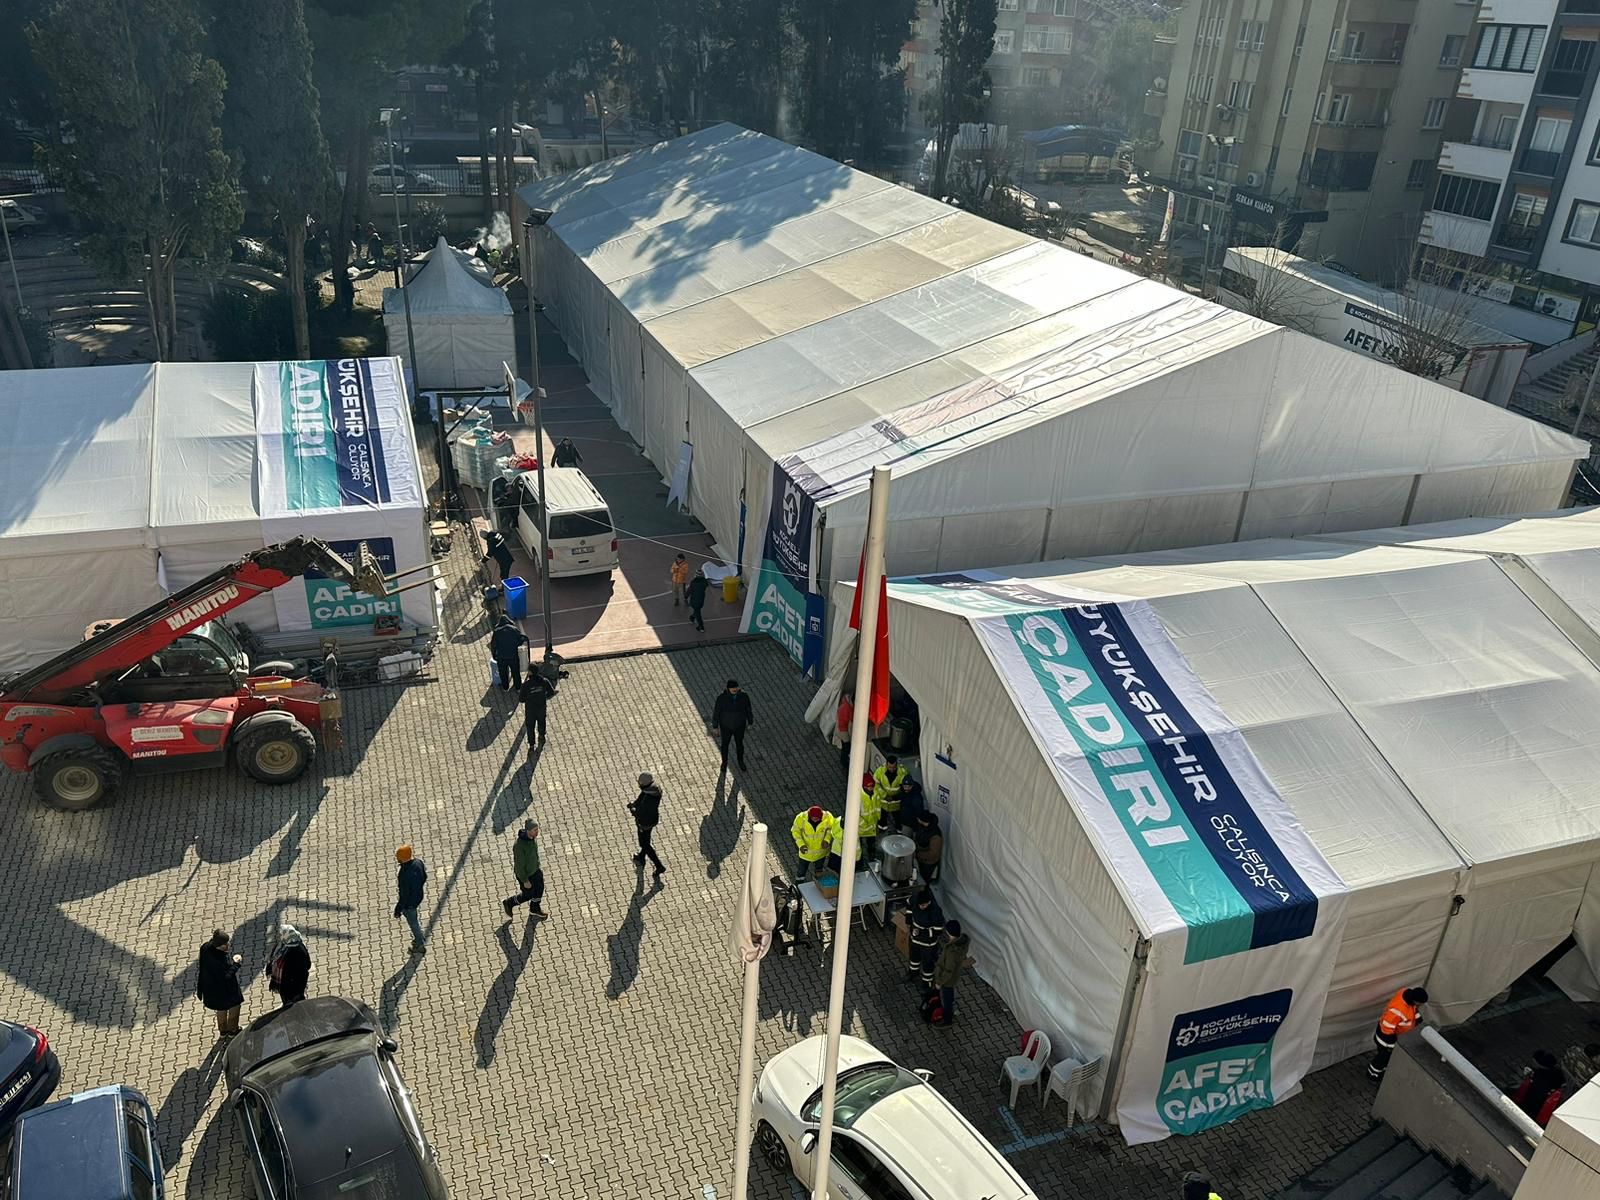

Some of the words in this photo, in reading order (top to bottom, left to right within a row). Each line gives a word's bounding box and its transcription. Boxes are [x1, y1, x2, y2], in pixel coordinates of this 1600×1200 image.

[1344, 328, 1382, 354] AFET
[290, 366, 328, 457] ADIRI
[337, 358, 364, 438] ÜKŞEHİR
[348, 444, 361, 481] OLUYOR
[166, 584, 239, 631] MANITOU
[313, 582, 393, 604] AFE
[314, 601, 397, 620] ÇADIRI
[760, 583, 805, 638] AFET
[756, 611, 804, 659] ÇADIR
[1075, 603, 1217, 803] ÜYÜKŞEHİR
[132, 749, 167, 759] MANITOU
[1017, 615, 1190, 847] ÇADIRI
[1210, 815, 1266, 888] OLUYOR
[1223, 813, 1290, 903] ÇALIŞINCA
[1202, 1012, 1248, 1029] KOCAELİ
[1163, 1080, 1268, 1125] ÇADIRI
